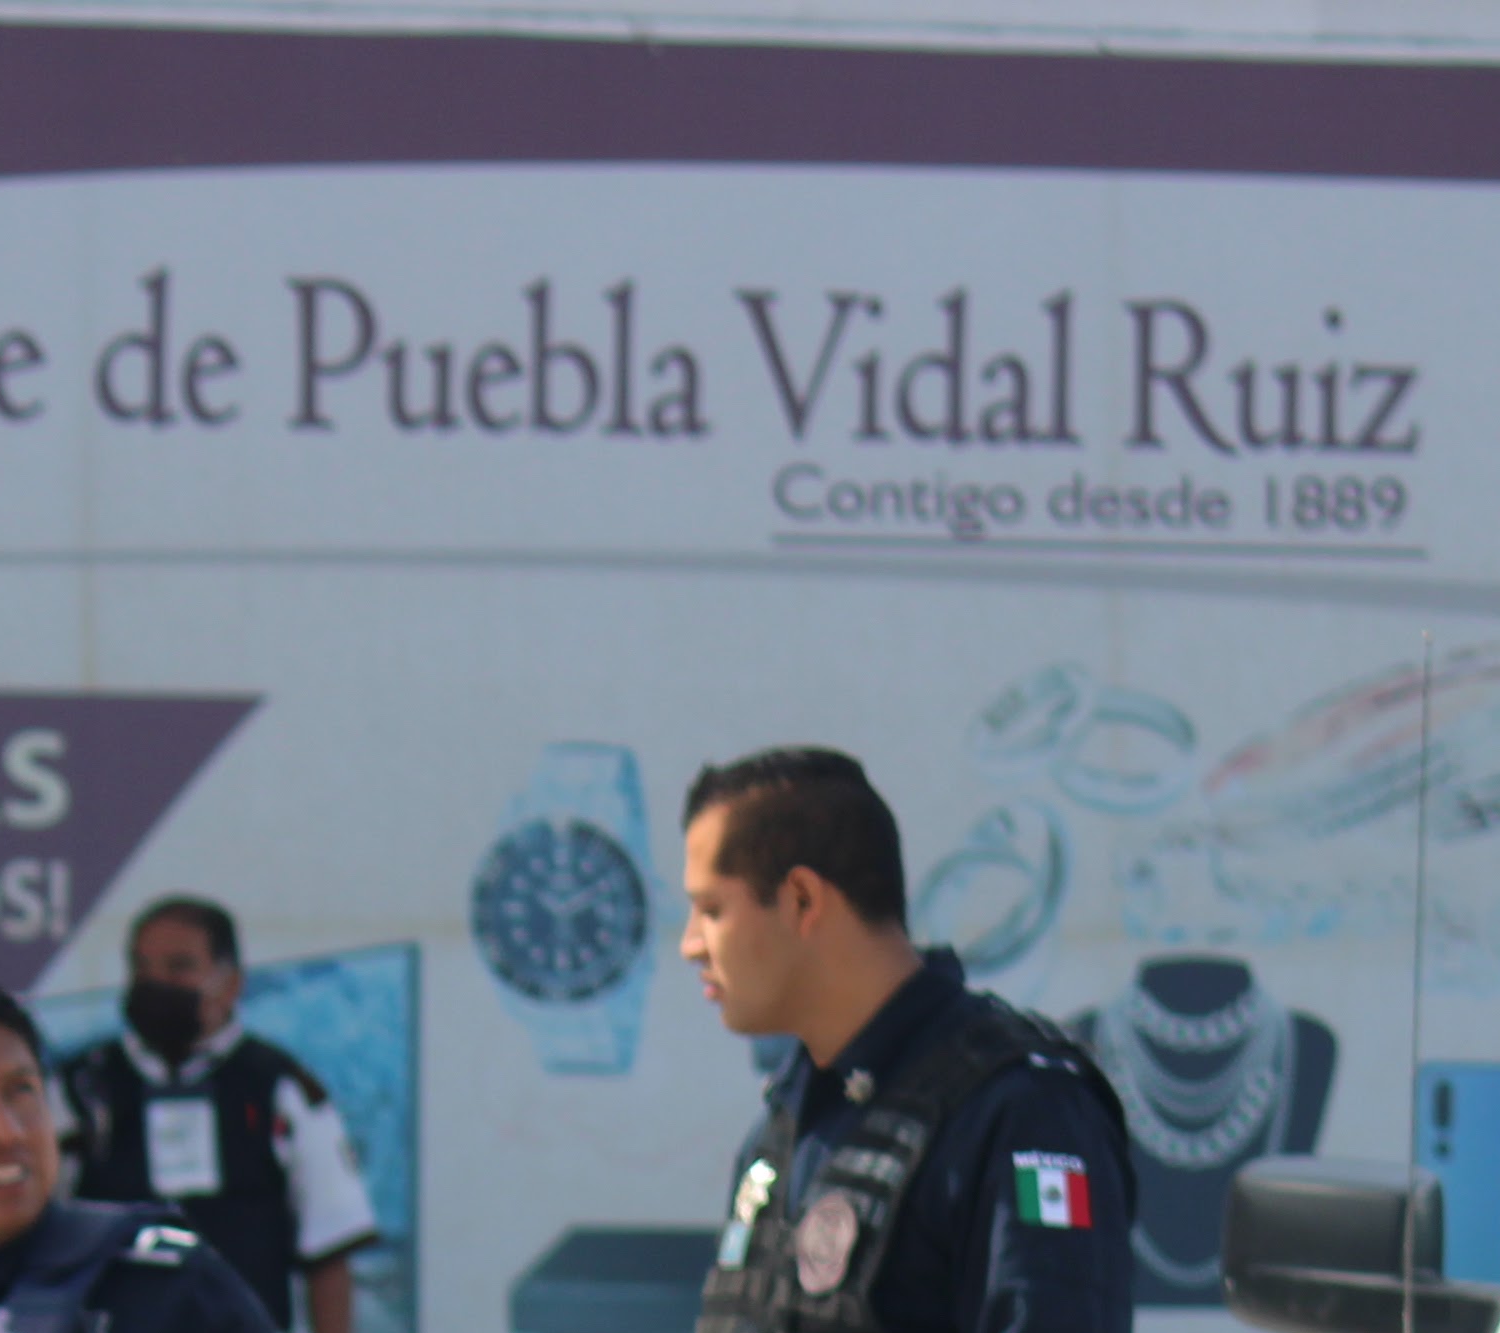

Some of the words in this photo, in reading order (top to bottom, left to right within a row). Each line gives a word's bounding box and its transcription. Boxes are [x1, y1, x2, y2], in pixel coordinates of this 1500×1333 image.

[94, 265, 240, 431] de
[287, 276, 710, 440] Puebla
[735, 286, 1085, 448] Vidal
[1124, 297, 1422, 458] Ruiz
[771, 462, 1027, 540] Contigo
[1048, 470, 1232, 531] desde
[1262, 476, 1408, 531] 1889
